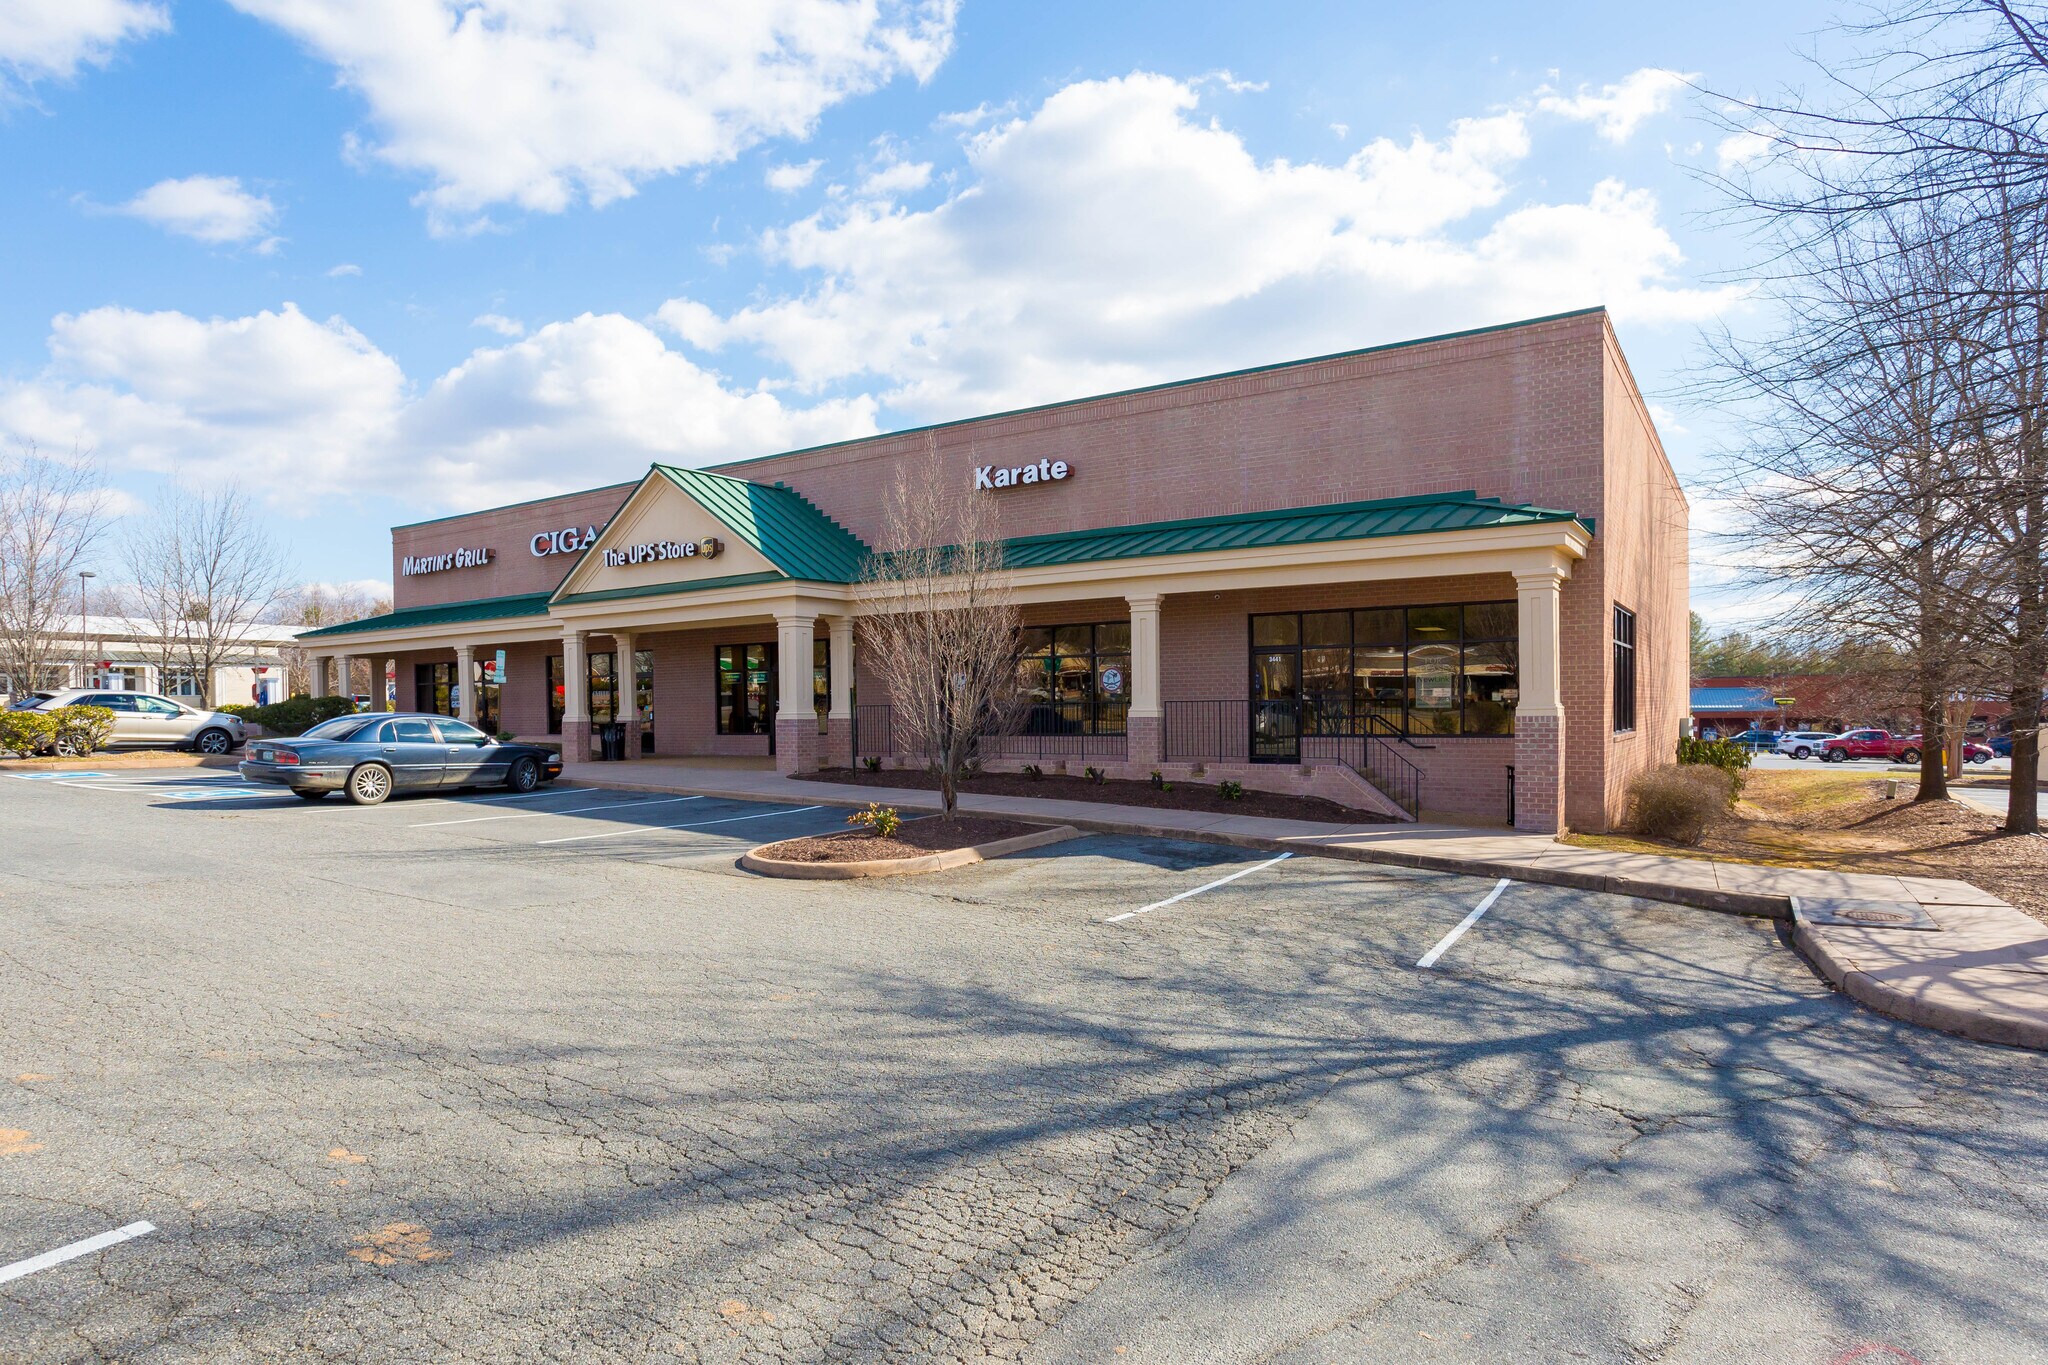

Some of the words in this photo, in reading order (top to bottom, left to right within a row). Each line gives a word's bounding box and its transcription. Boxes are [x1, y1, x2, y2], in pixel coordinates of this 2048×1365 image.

[975, 458, 1068, 490] Karate
[530, 522, 607, 557] CIGA
[602, 548, 626, 567] The
[628, 543, 655, 564] UPS
[658, 541, 695, 561] Store
[402, 552, 453, 576] MARTIN'S
[455, 547, 488, 568] GRILL
